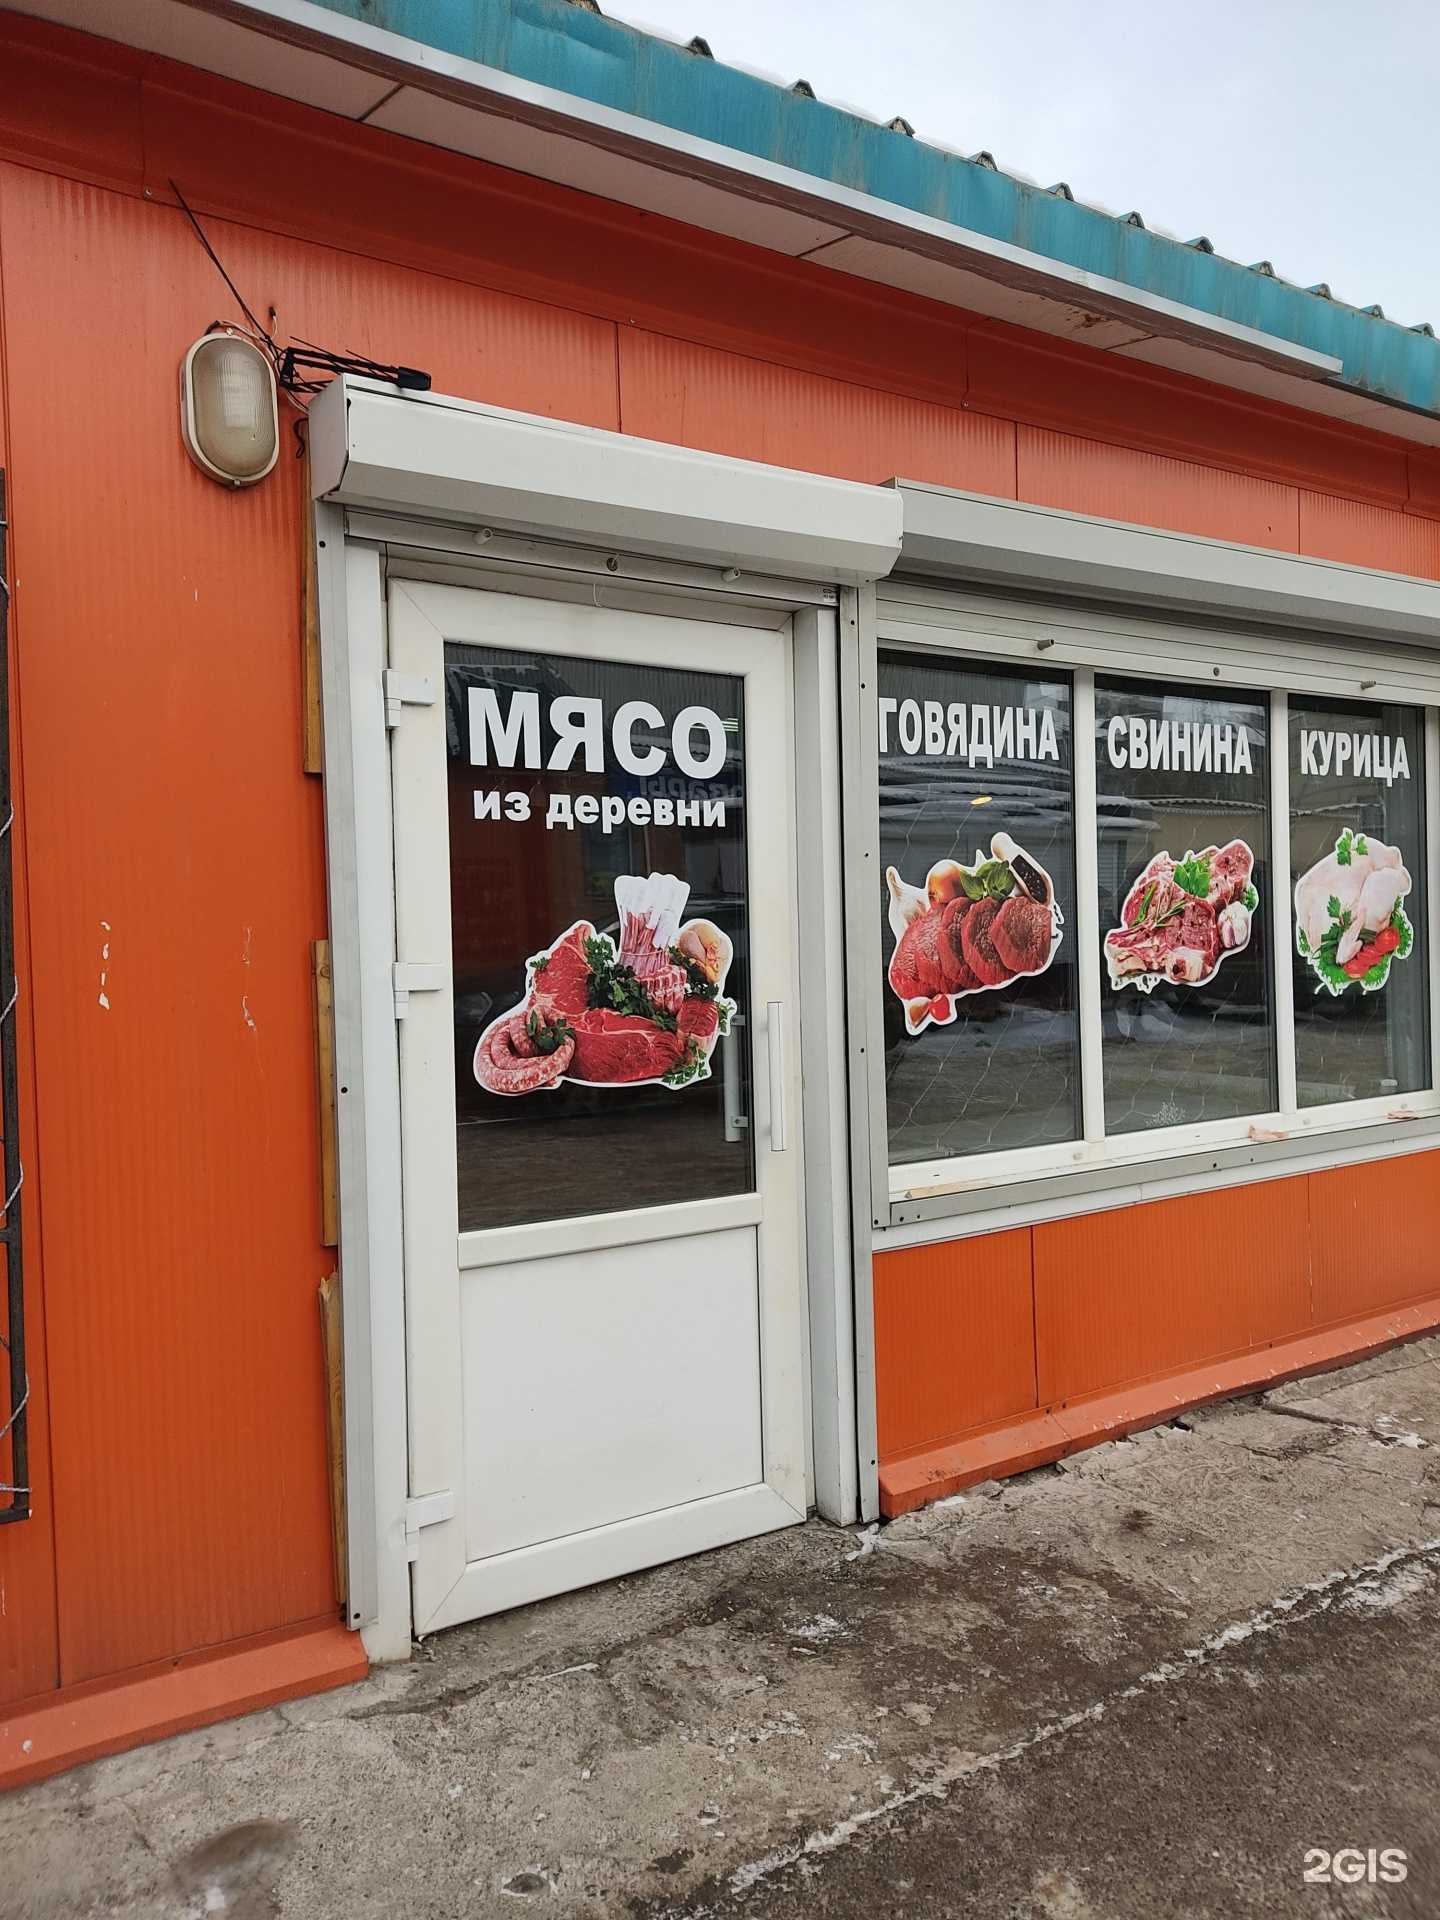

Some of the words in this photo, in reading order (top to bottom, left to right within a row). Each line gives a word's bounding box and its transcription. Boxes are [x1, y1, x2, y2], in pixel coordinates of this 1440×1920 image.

[467, 686, 727, 779] МЯСО
[878, 697, 1060, 769] ГОВЯДИНА
[1107, 715, 1253, 775] СВИНИНА
[1300, 729, 1411, 788] КУРИЦА
[473, 790, 531, 822] из
[545, 793, 727, 834] деревни
